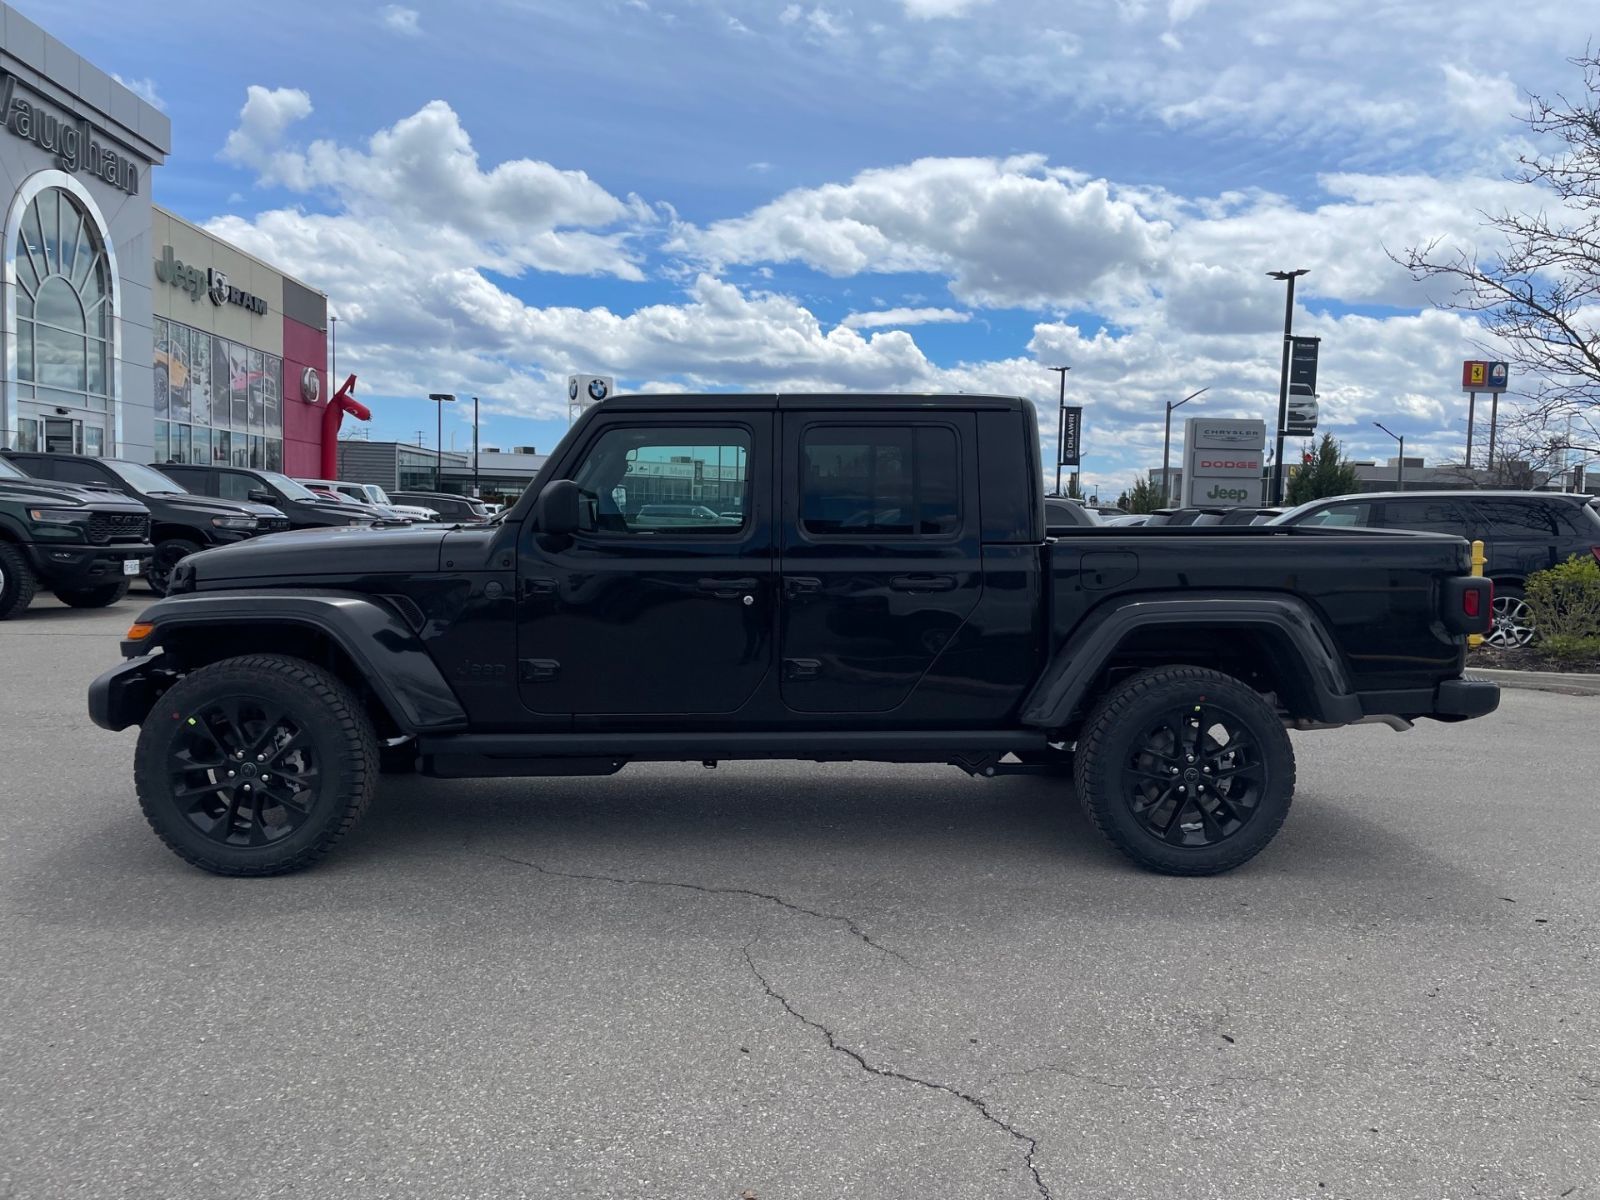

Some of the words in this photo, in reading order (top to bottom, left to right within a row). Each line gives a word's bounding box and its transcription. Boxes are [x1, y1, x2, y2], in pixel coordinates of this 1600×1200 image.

[155, 245, 206, 301] Jeep
[230, 285, 267, 315] RAM
[1067, 413, 1075, 449] DILAWRI
[1200, 461, 1258, 469] DODGE
[1206, 485, 1248, 502] Jeep
